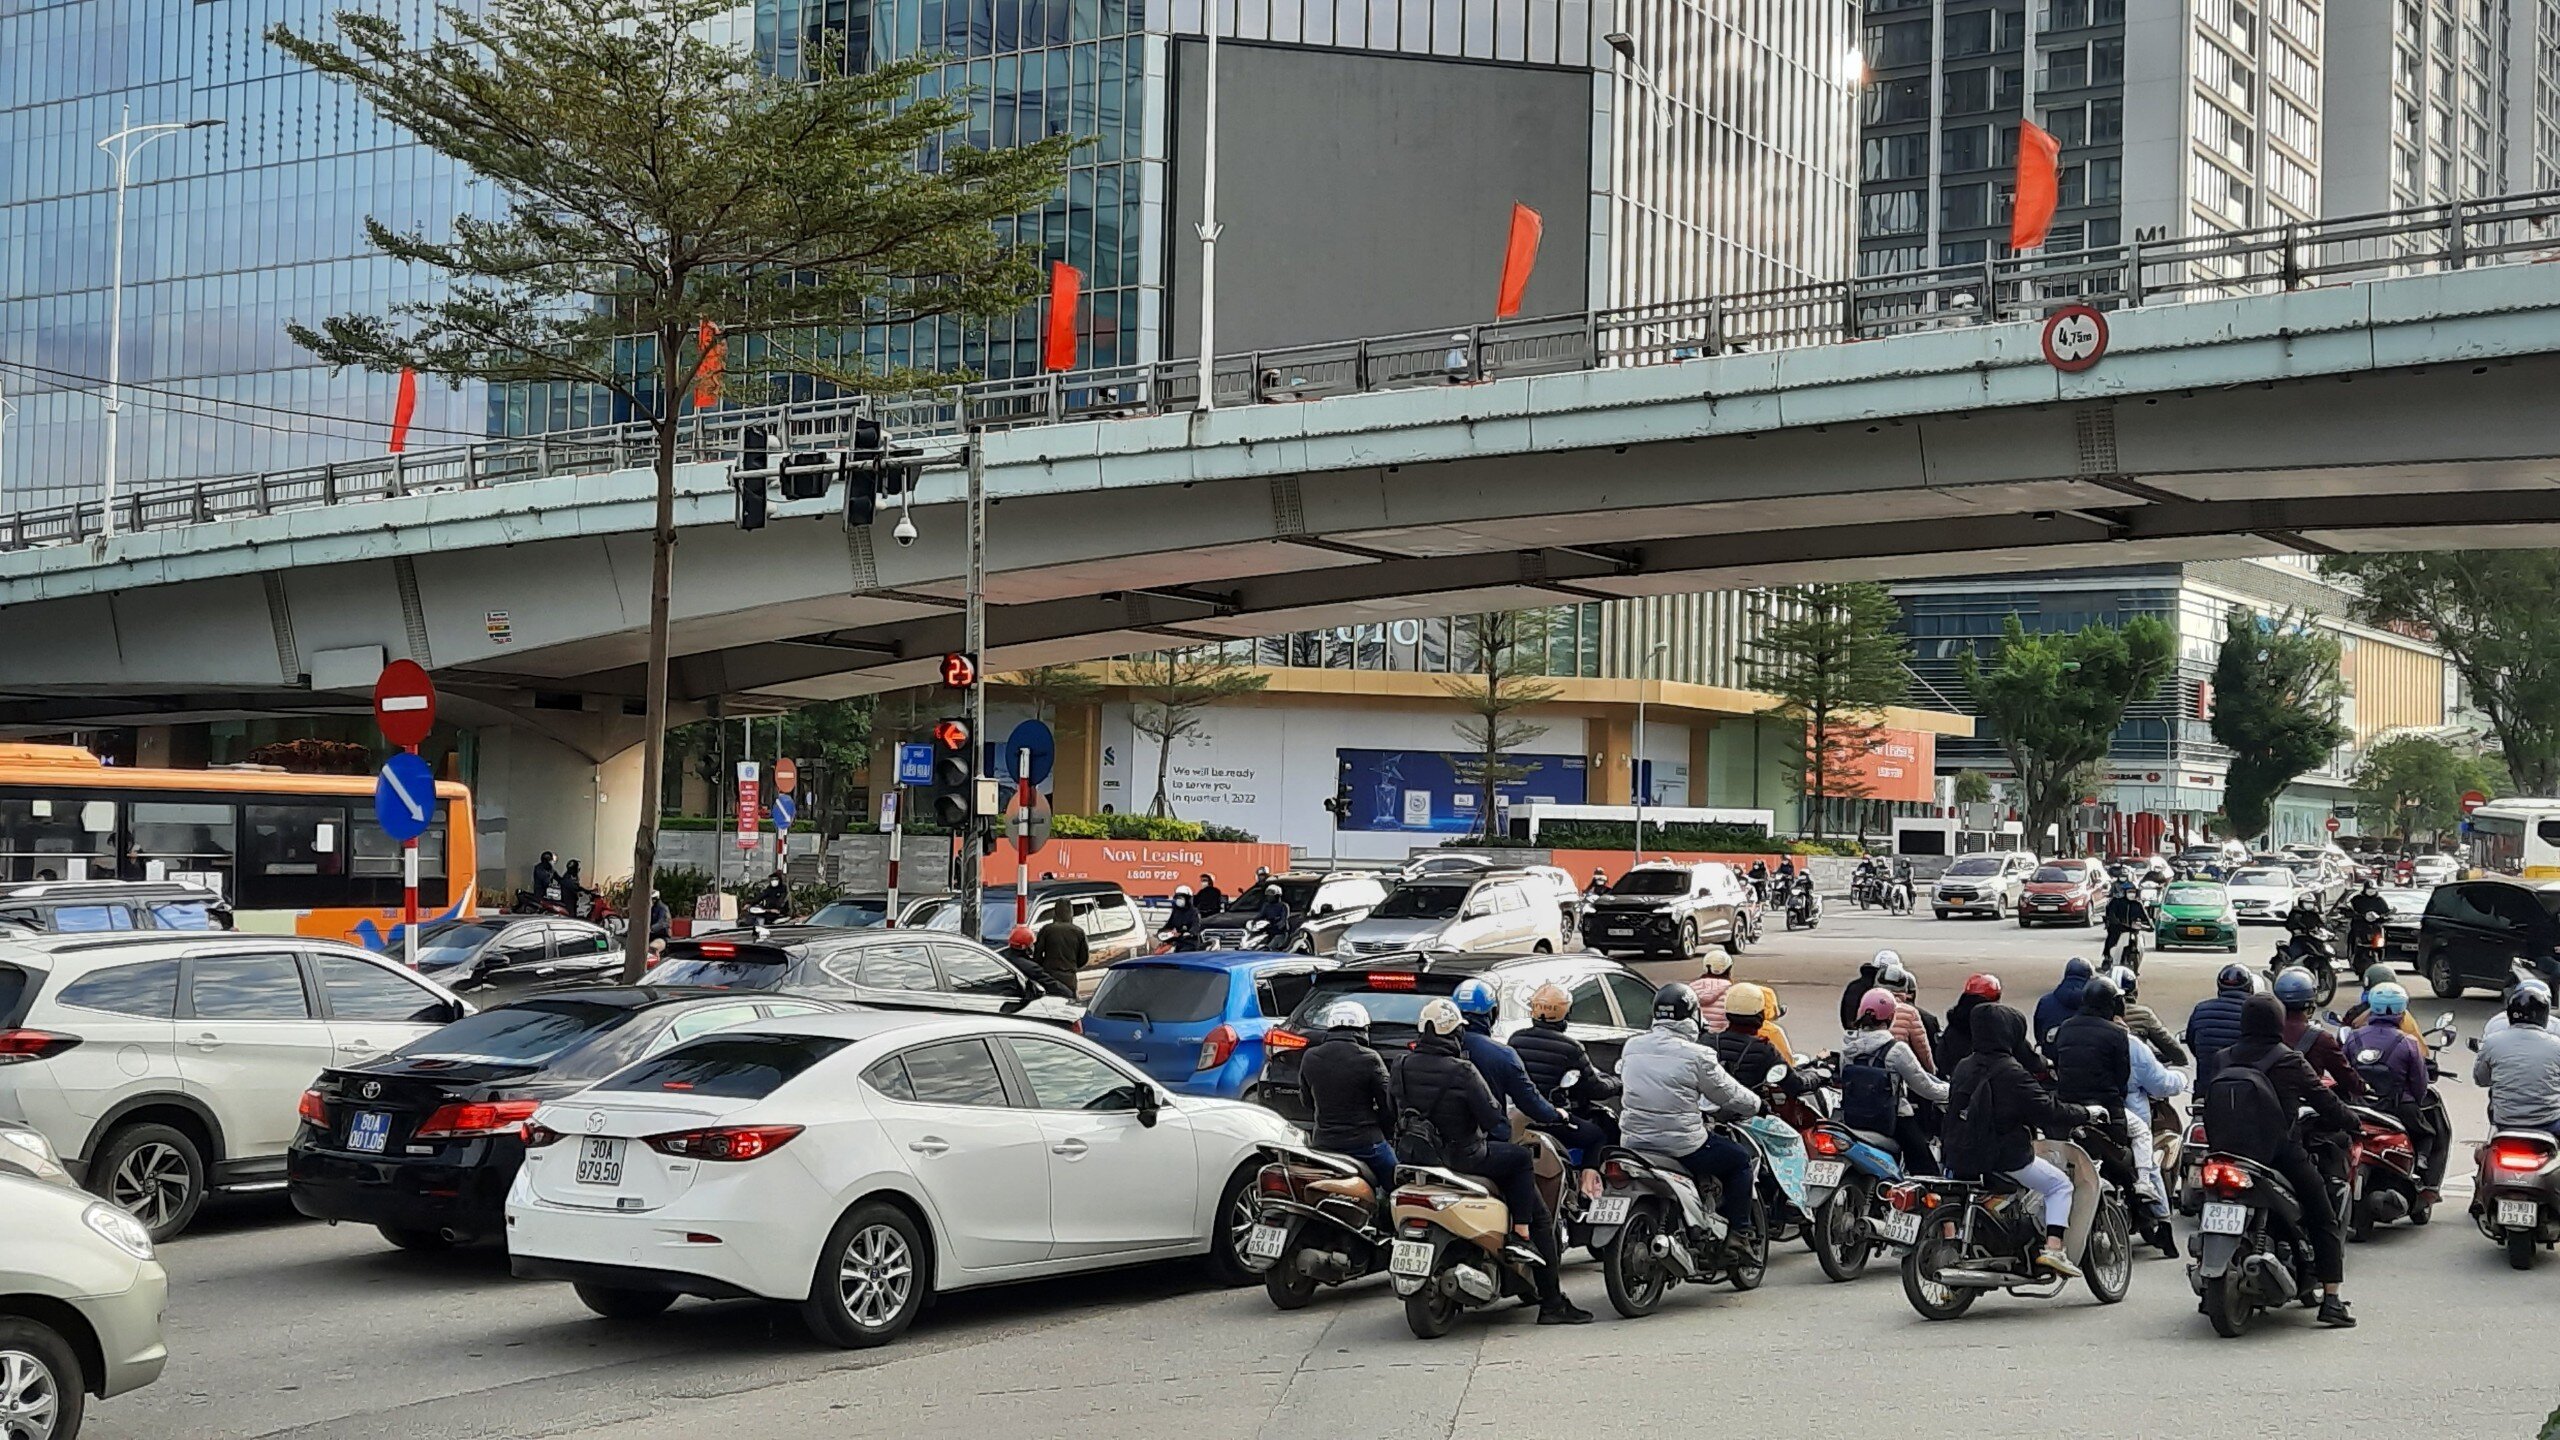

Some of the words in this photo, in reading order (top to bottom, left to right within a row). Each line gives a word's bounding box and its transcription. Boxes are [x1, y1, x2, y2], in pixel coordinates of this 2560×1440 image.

[2135, 225, 2166, 242] M1
[1226, 768, 1255, 780] ready
[1214, 783, 1231, 792] you
[1231, 794, 1256, 804] 2022
[1103, 847, 1138, 862] Now
[1142, 847, 1203, 866] Leasing
[590, 1140, 613, 1160] 30A
[578, 1160, 620, 1181] 979.50
